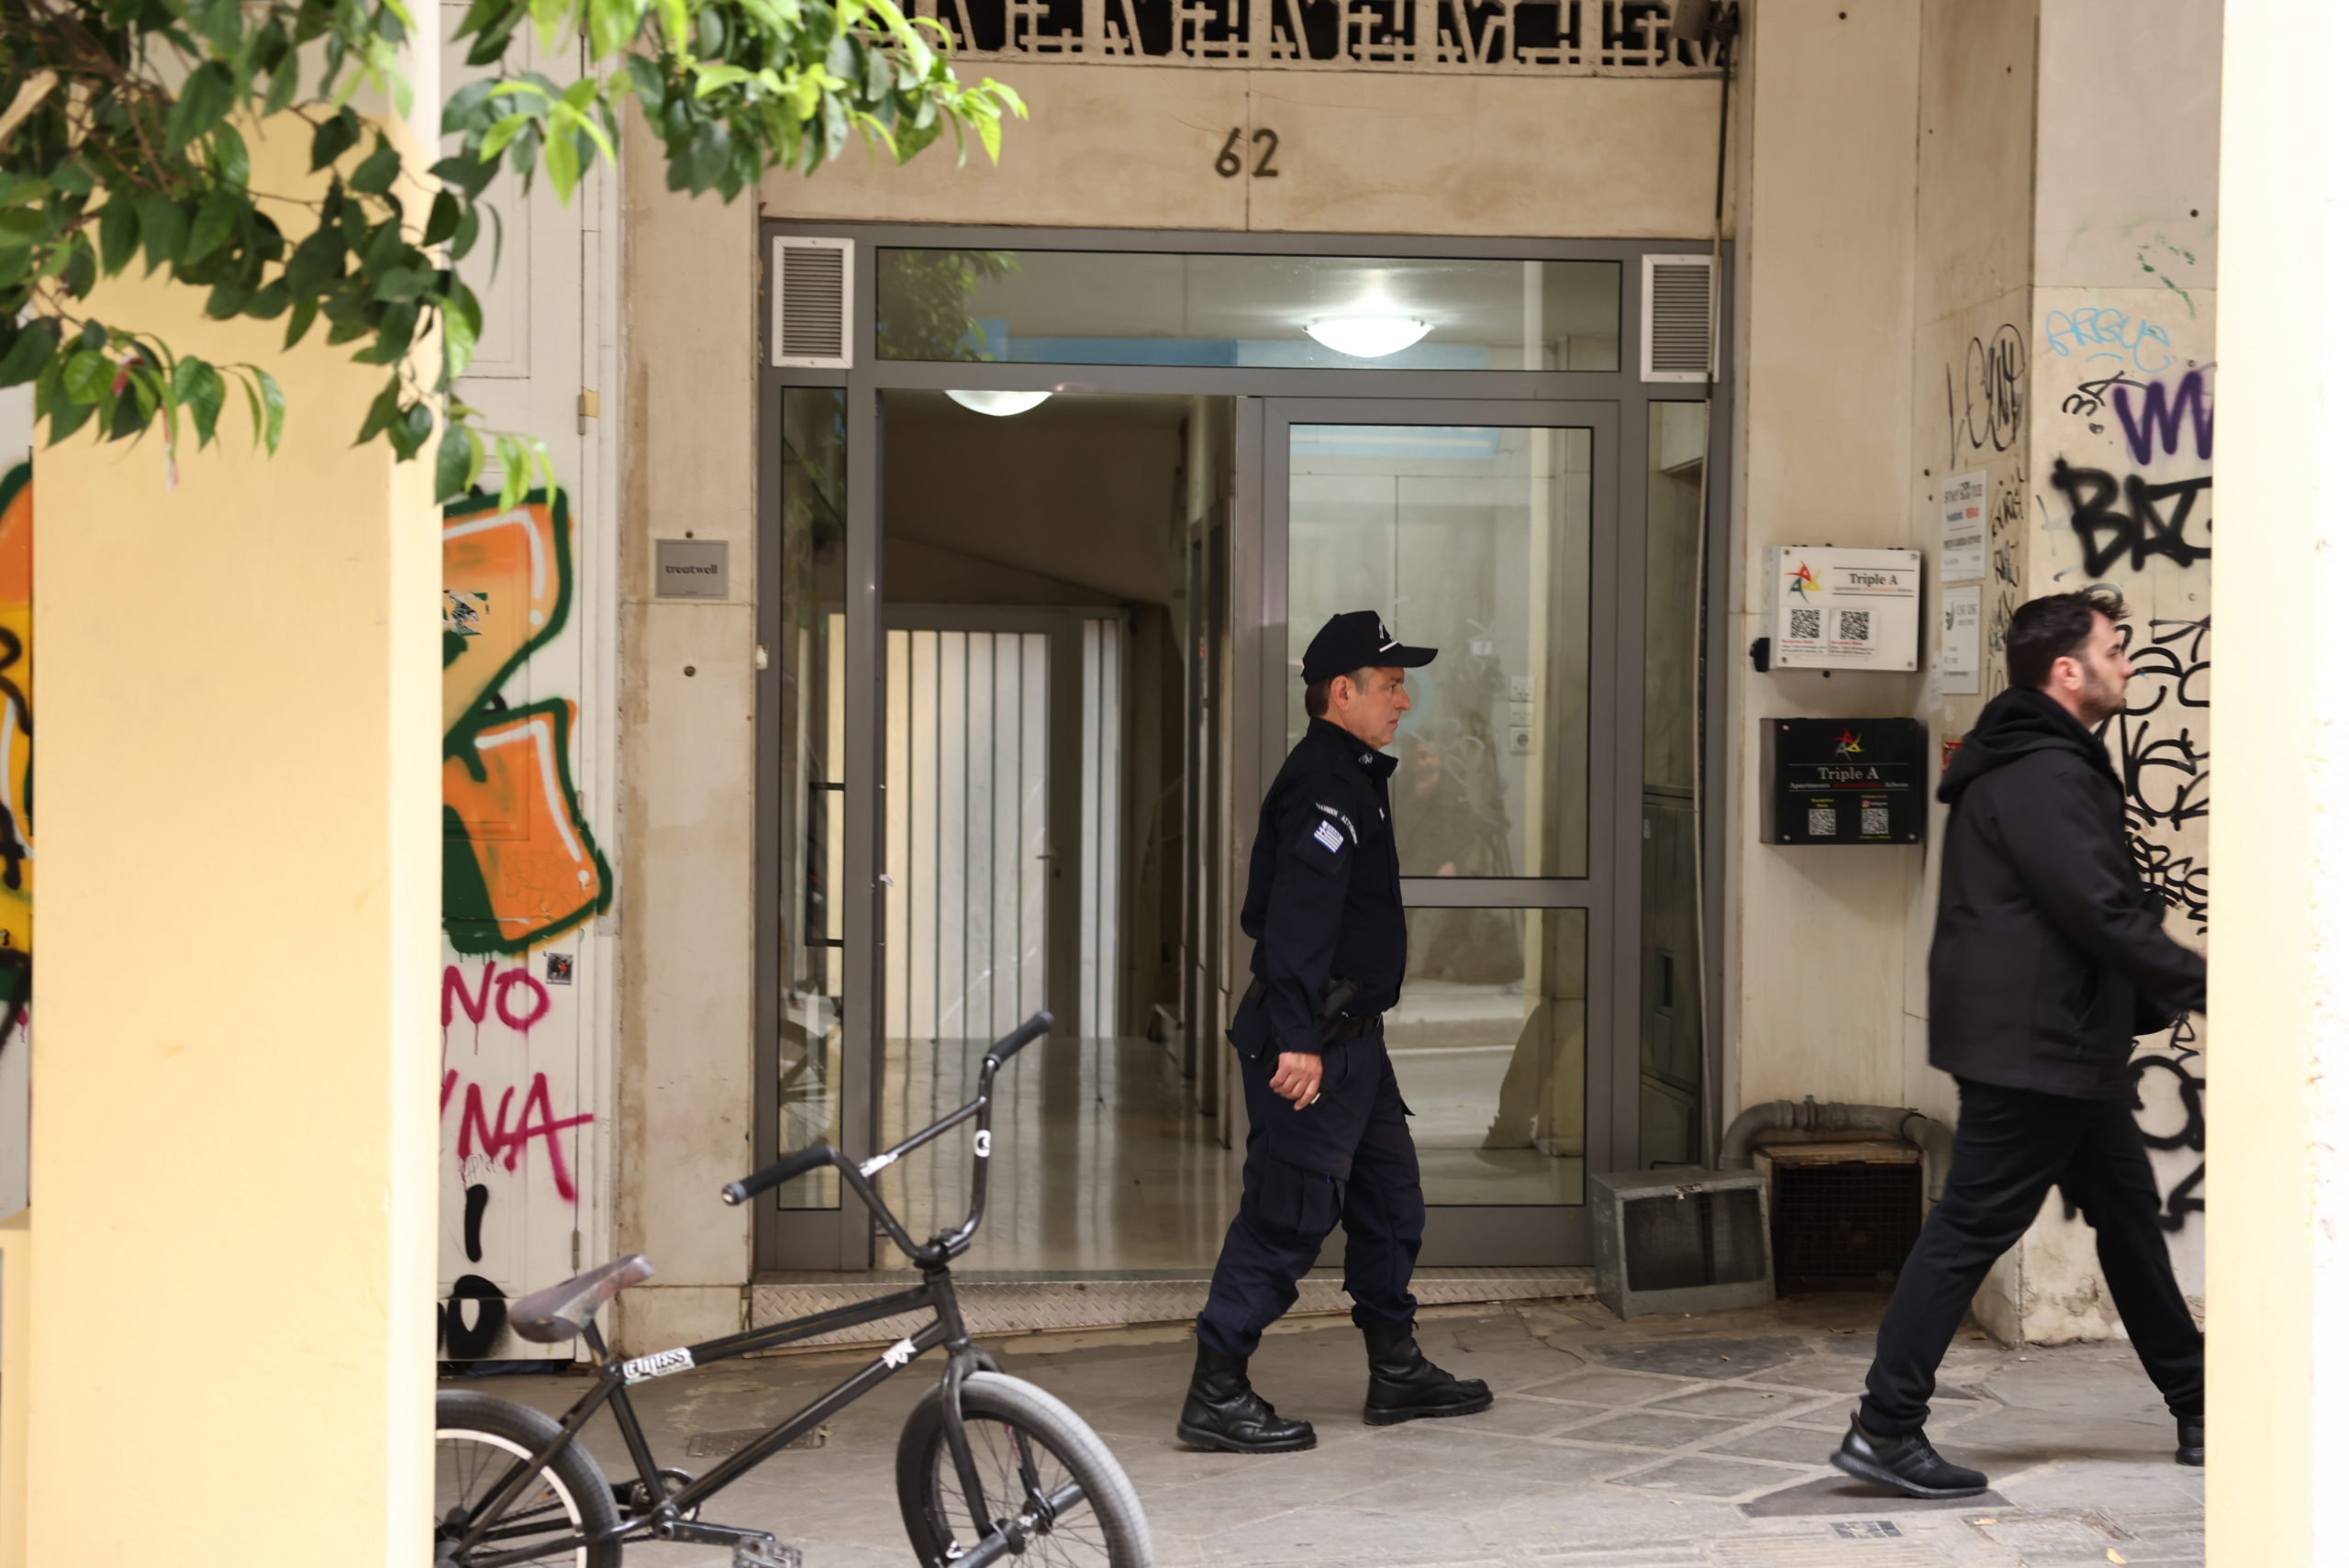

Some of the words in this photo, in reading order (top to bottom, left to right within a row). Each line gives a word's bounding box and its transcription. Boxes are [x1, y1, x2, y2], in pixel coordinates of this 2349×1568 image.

[1214, 127, 1279, 178] 62
[664, 563, 718, 574] treatwell
[1848, 573, 1887, 587] Triple
[1888, 574, 1898, 585] A
[1817, 766, 1864, 783] Triple
[1866, 766, 1880, 780] A
